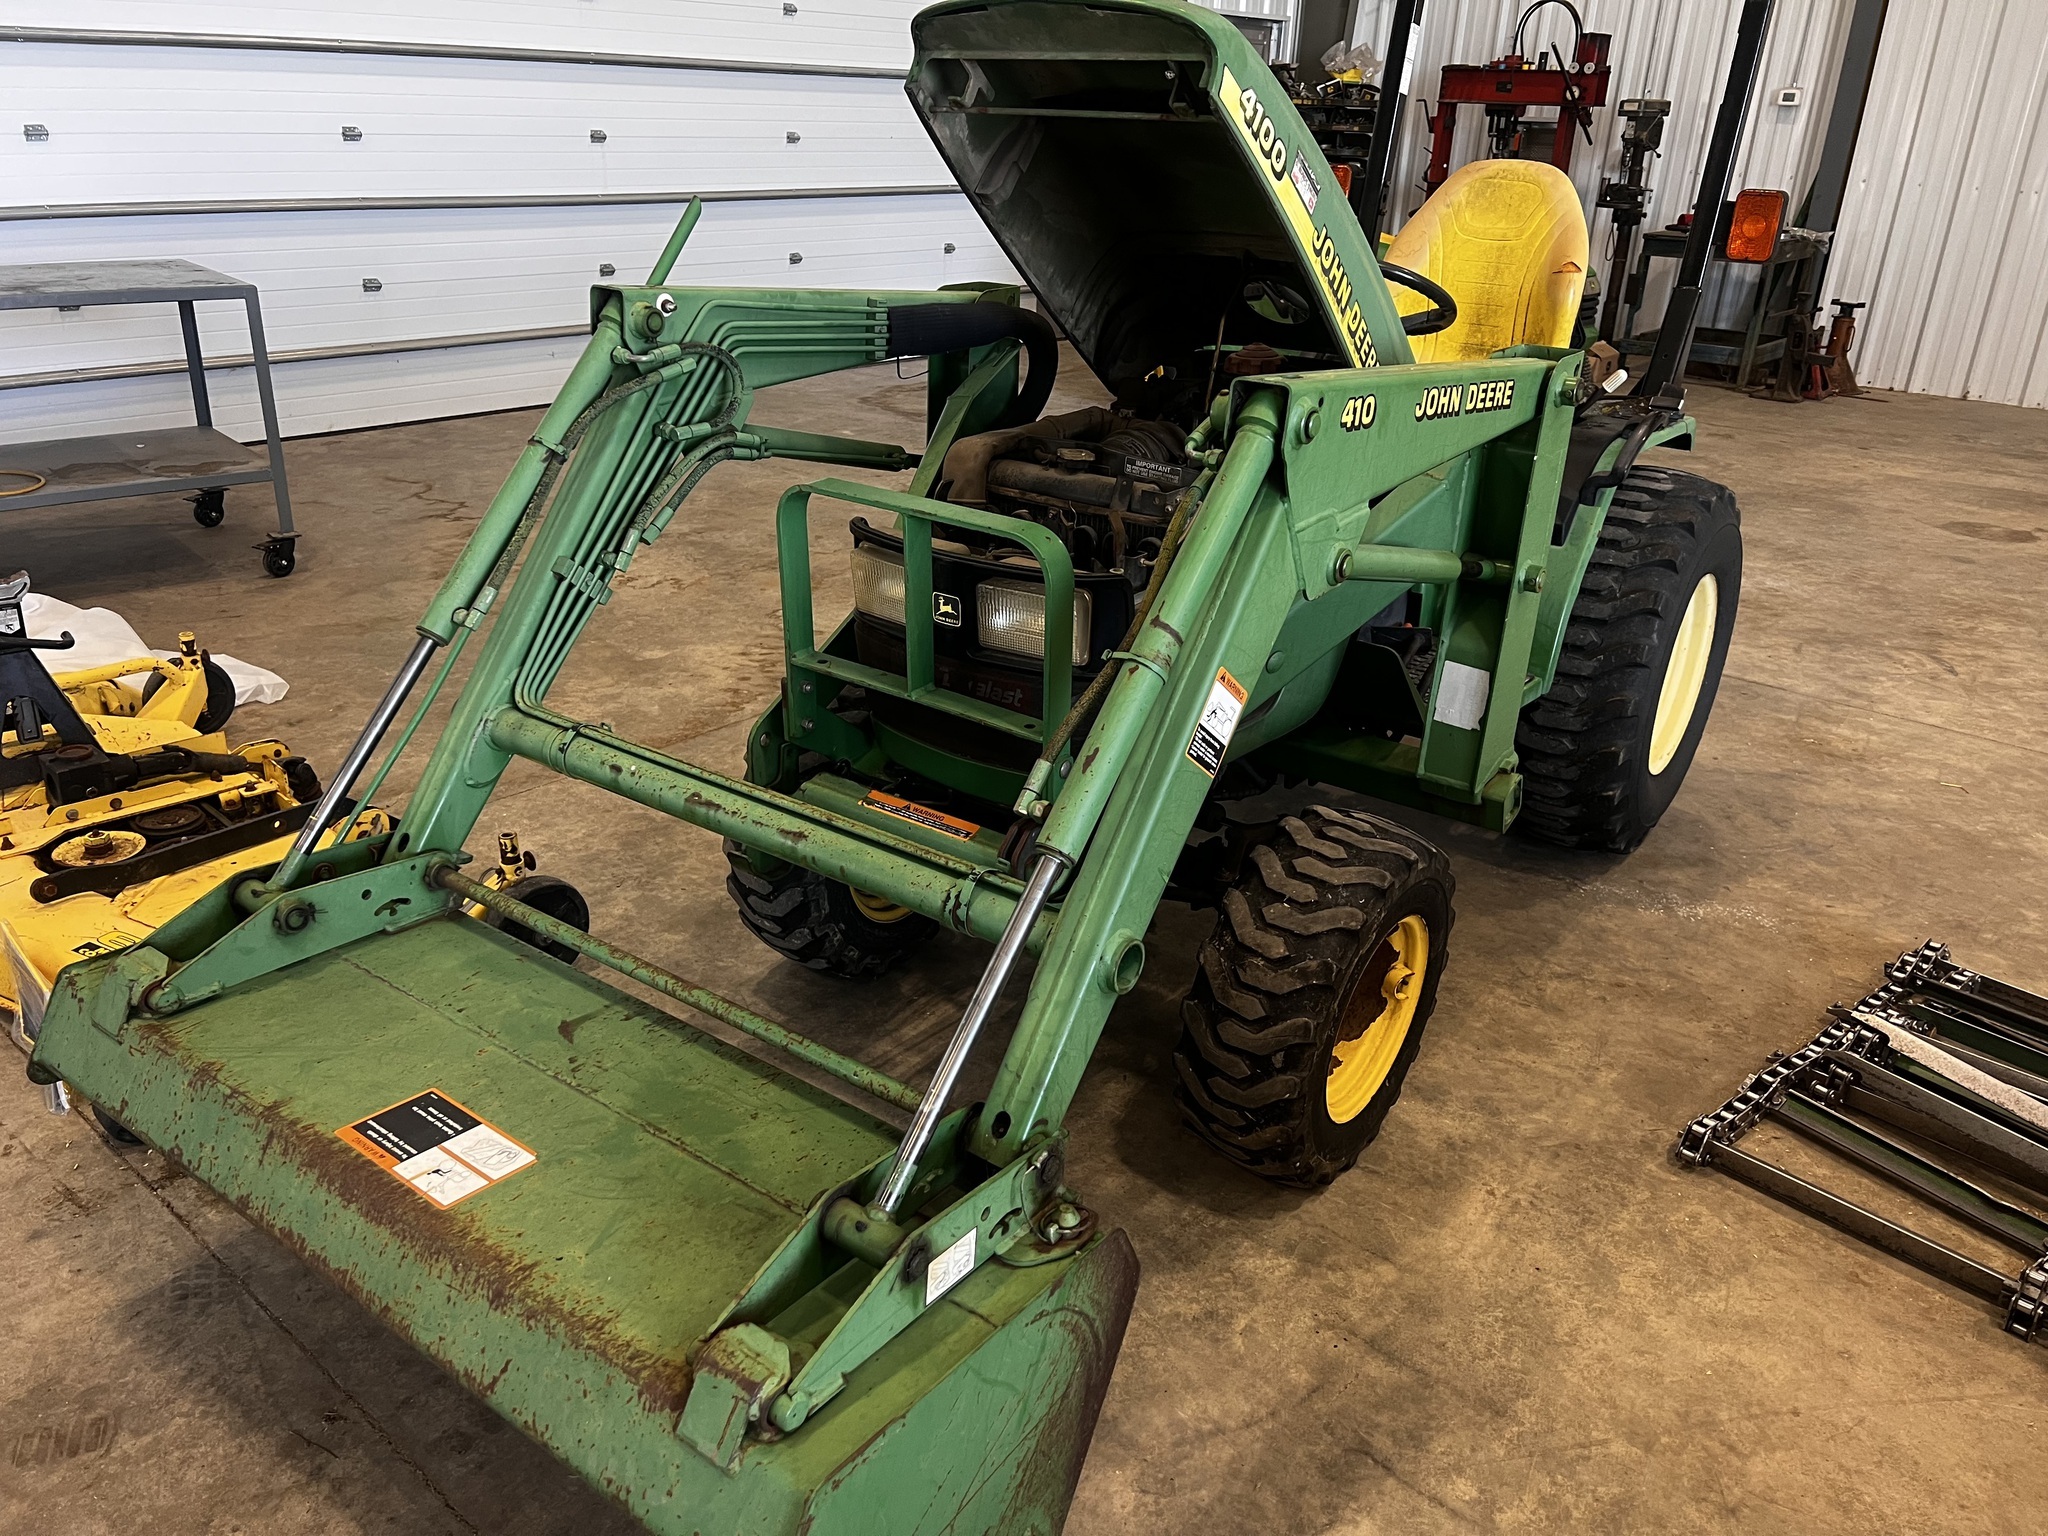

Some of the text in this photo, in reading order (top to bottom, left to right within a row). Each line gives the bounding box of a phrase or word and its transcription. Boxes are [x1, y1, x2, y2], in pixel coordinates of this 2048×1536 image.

[1239, 87, 1288, 181] 4100
[1312, 225, 1381, 368] JOHN DEER
[1340, 394, 1376, 432] 410
[1415, 379, 1515, 422] JOHN DEERE
[1135, 460, 1171, 474] IMPORTANT
[1226, 678, 1245, 700] WARNING
[912, 806, 945, 822] WARNING
[352, 1137, 380, 1157] WARNING
